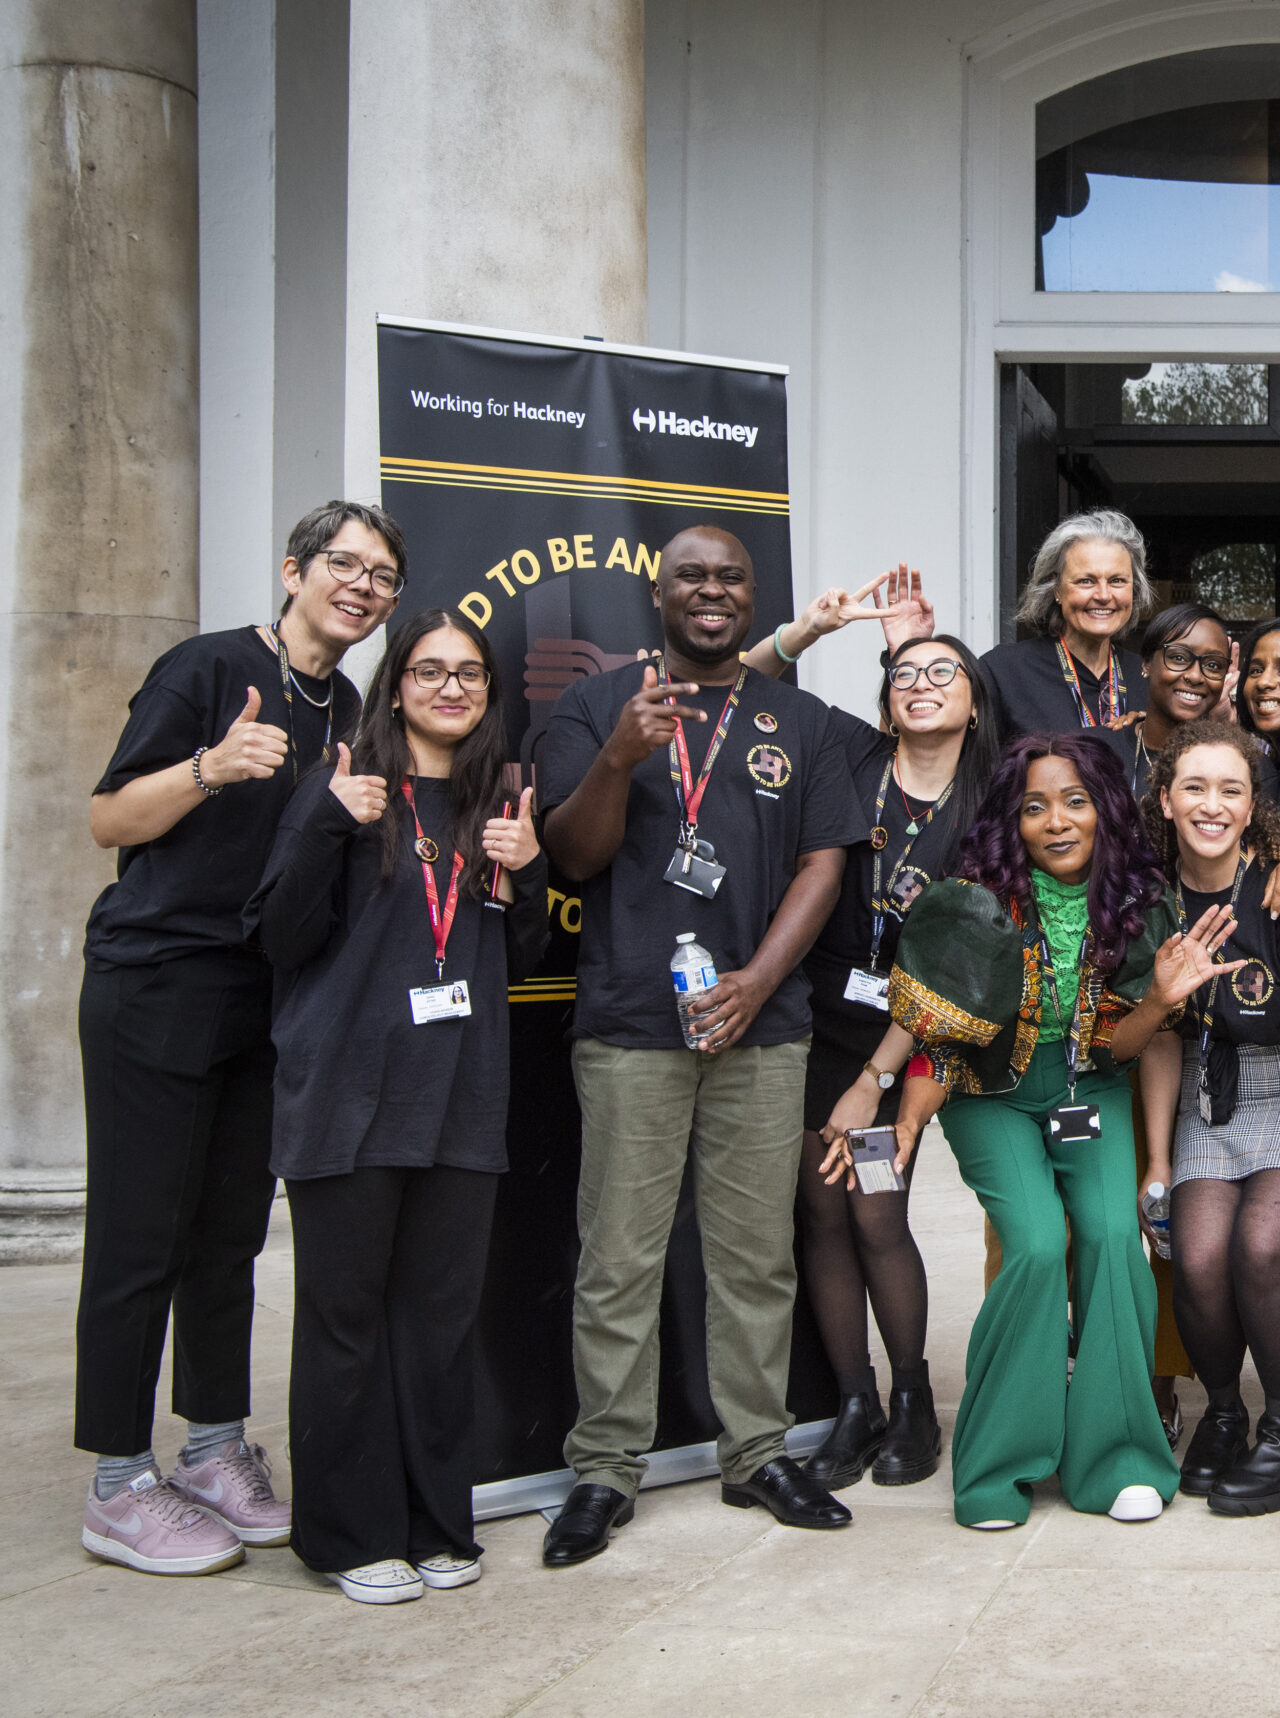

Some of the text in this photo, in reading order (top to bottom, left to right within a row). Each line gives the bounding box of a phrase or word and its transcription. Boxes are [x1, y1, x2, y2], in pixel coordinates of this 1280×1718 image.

[411, 390, 586, 429] Working for Hackney
[659, 410, 759, 448] Hackney
[485, 549, 541, 598] TO
[547, 534, 598, 574] BE
[547, 886, 582, 933] TO
